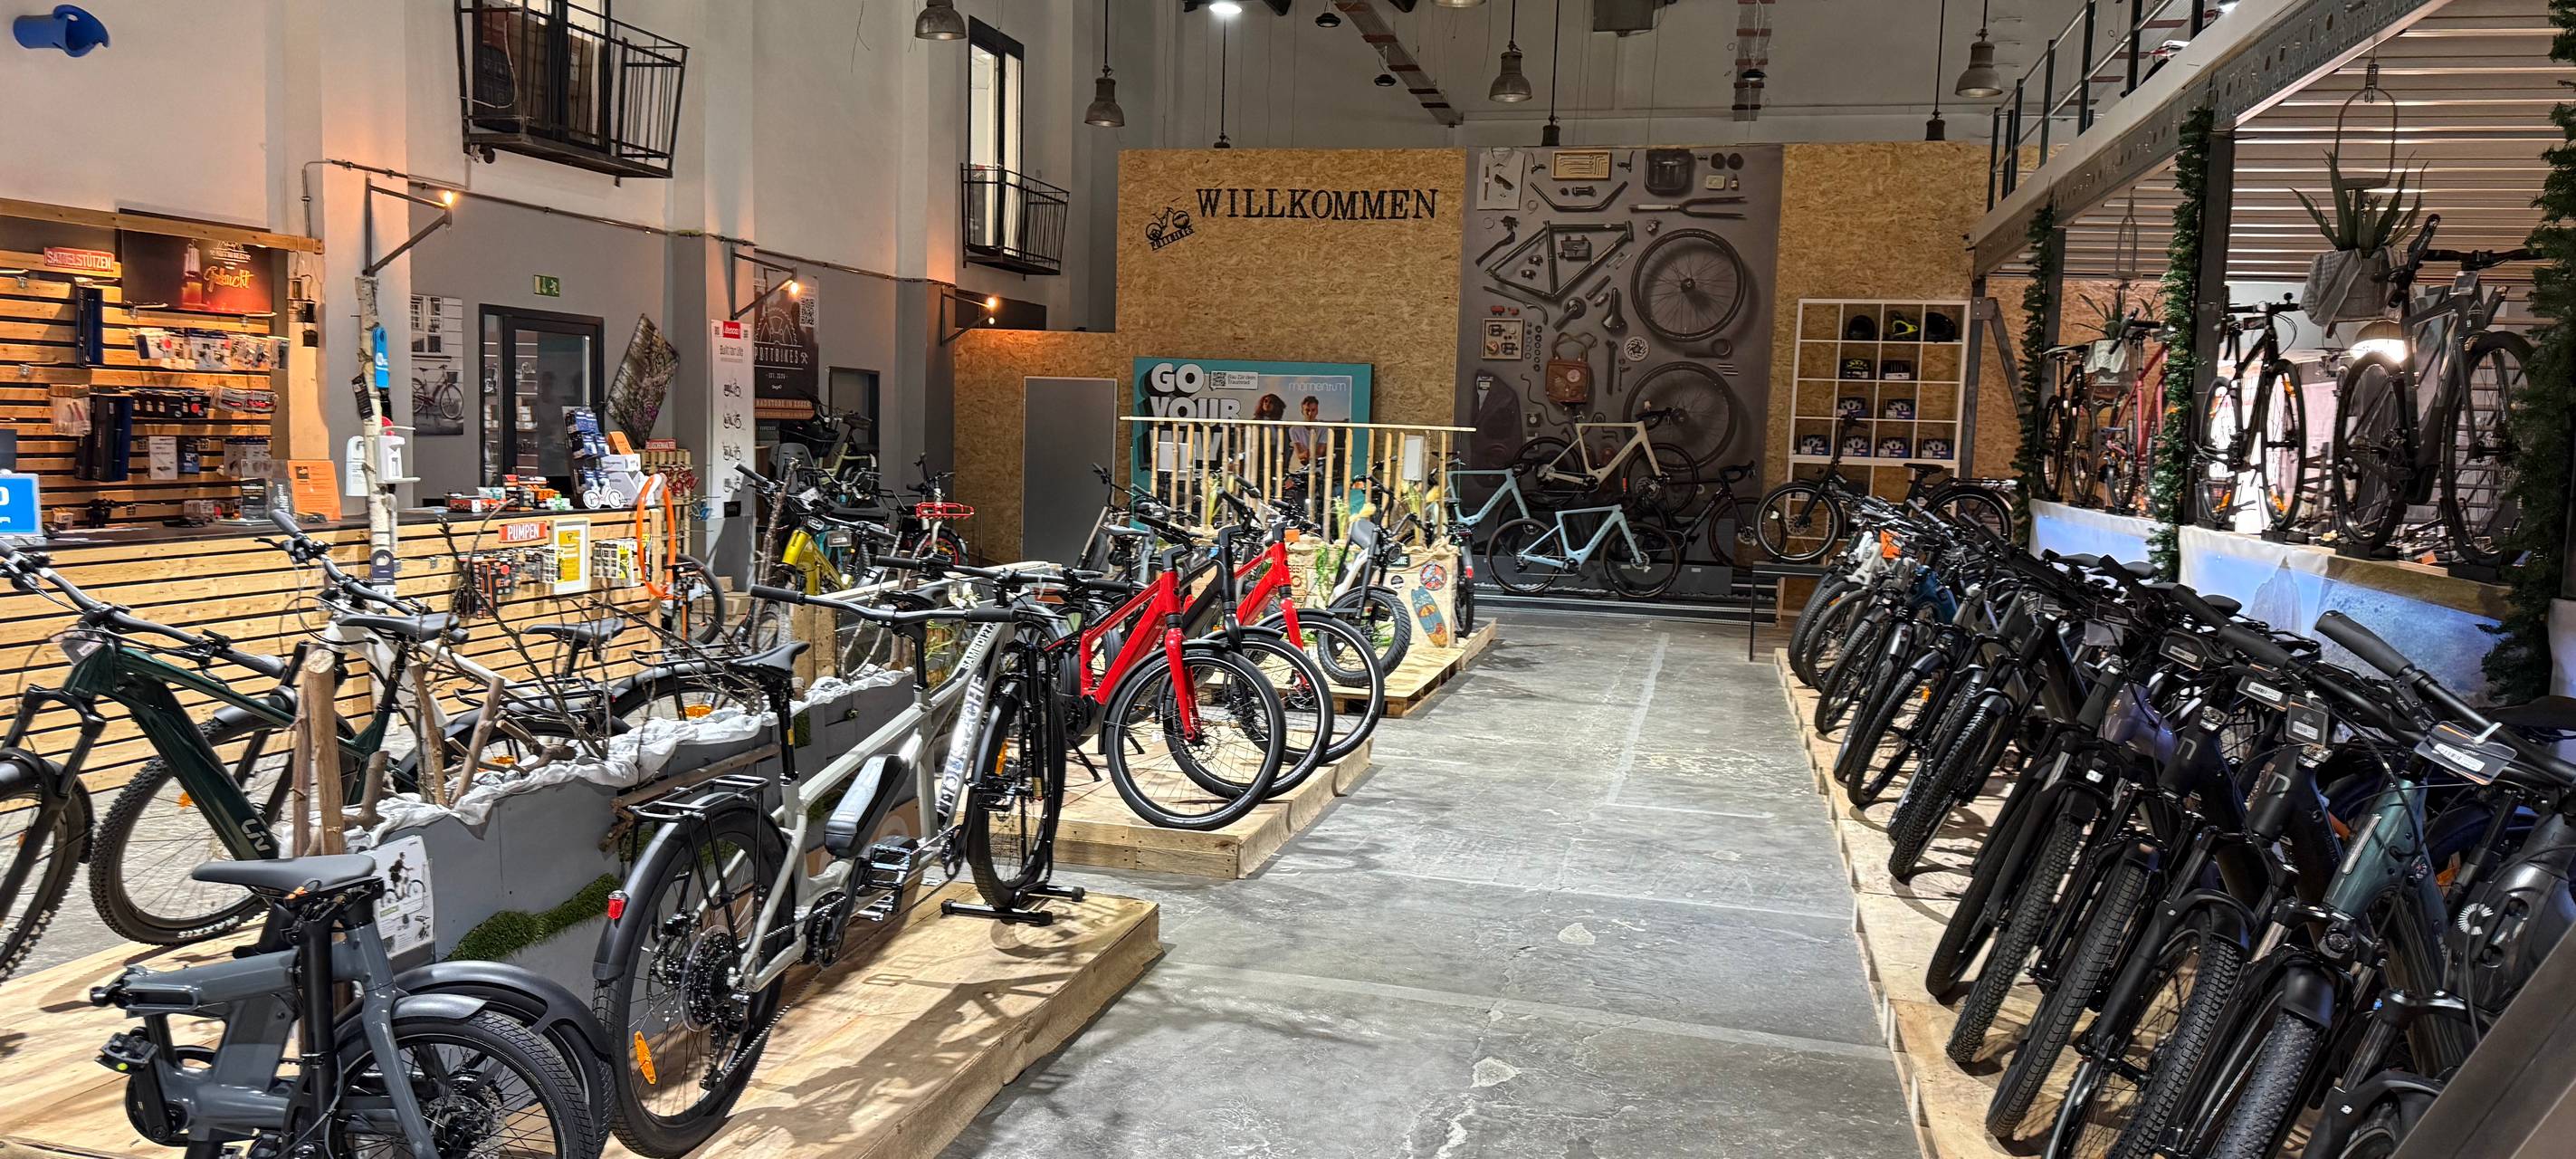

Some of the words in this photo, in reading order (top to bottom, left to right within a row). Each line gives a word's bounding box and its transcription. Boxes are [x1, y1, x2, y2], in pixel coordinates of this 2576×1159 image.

[1196, 188, 1439, 220] WILLKOMMEN
[47, 252, 112, 270] SATTELSTÜTZEN
[1150, 362, 1205, 393] GO
[1289, 382, 1347, 391] momentum
[1150, 396, 1241, 428] YOUR
[508, 523, 539, 541] PUMPEN
[241, 819, 271, 851] Liv
